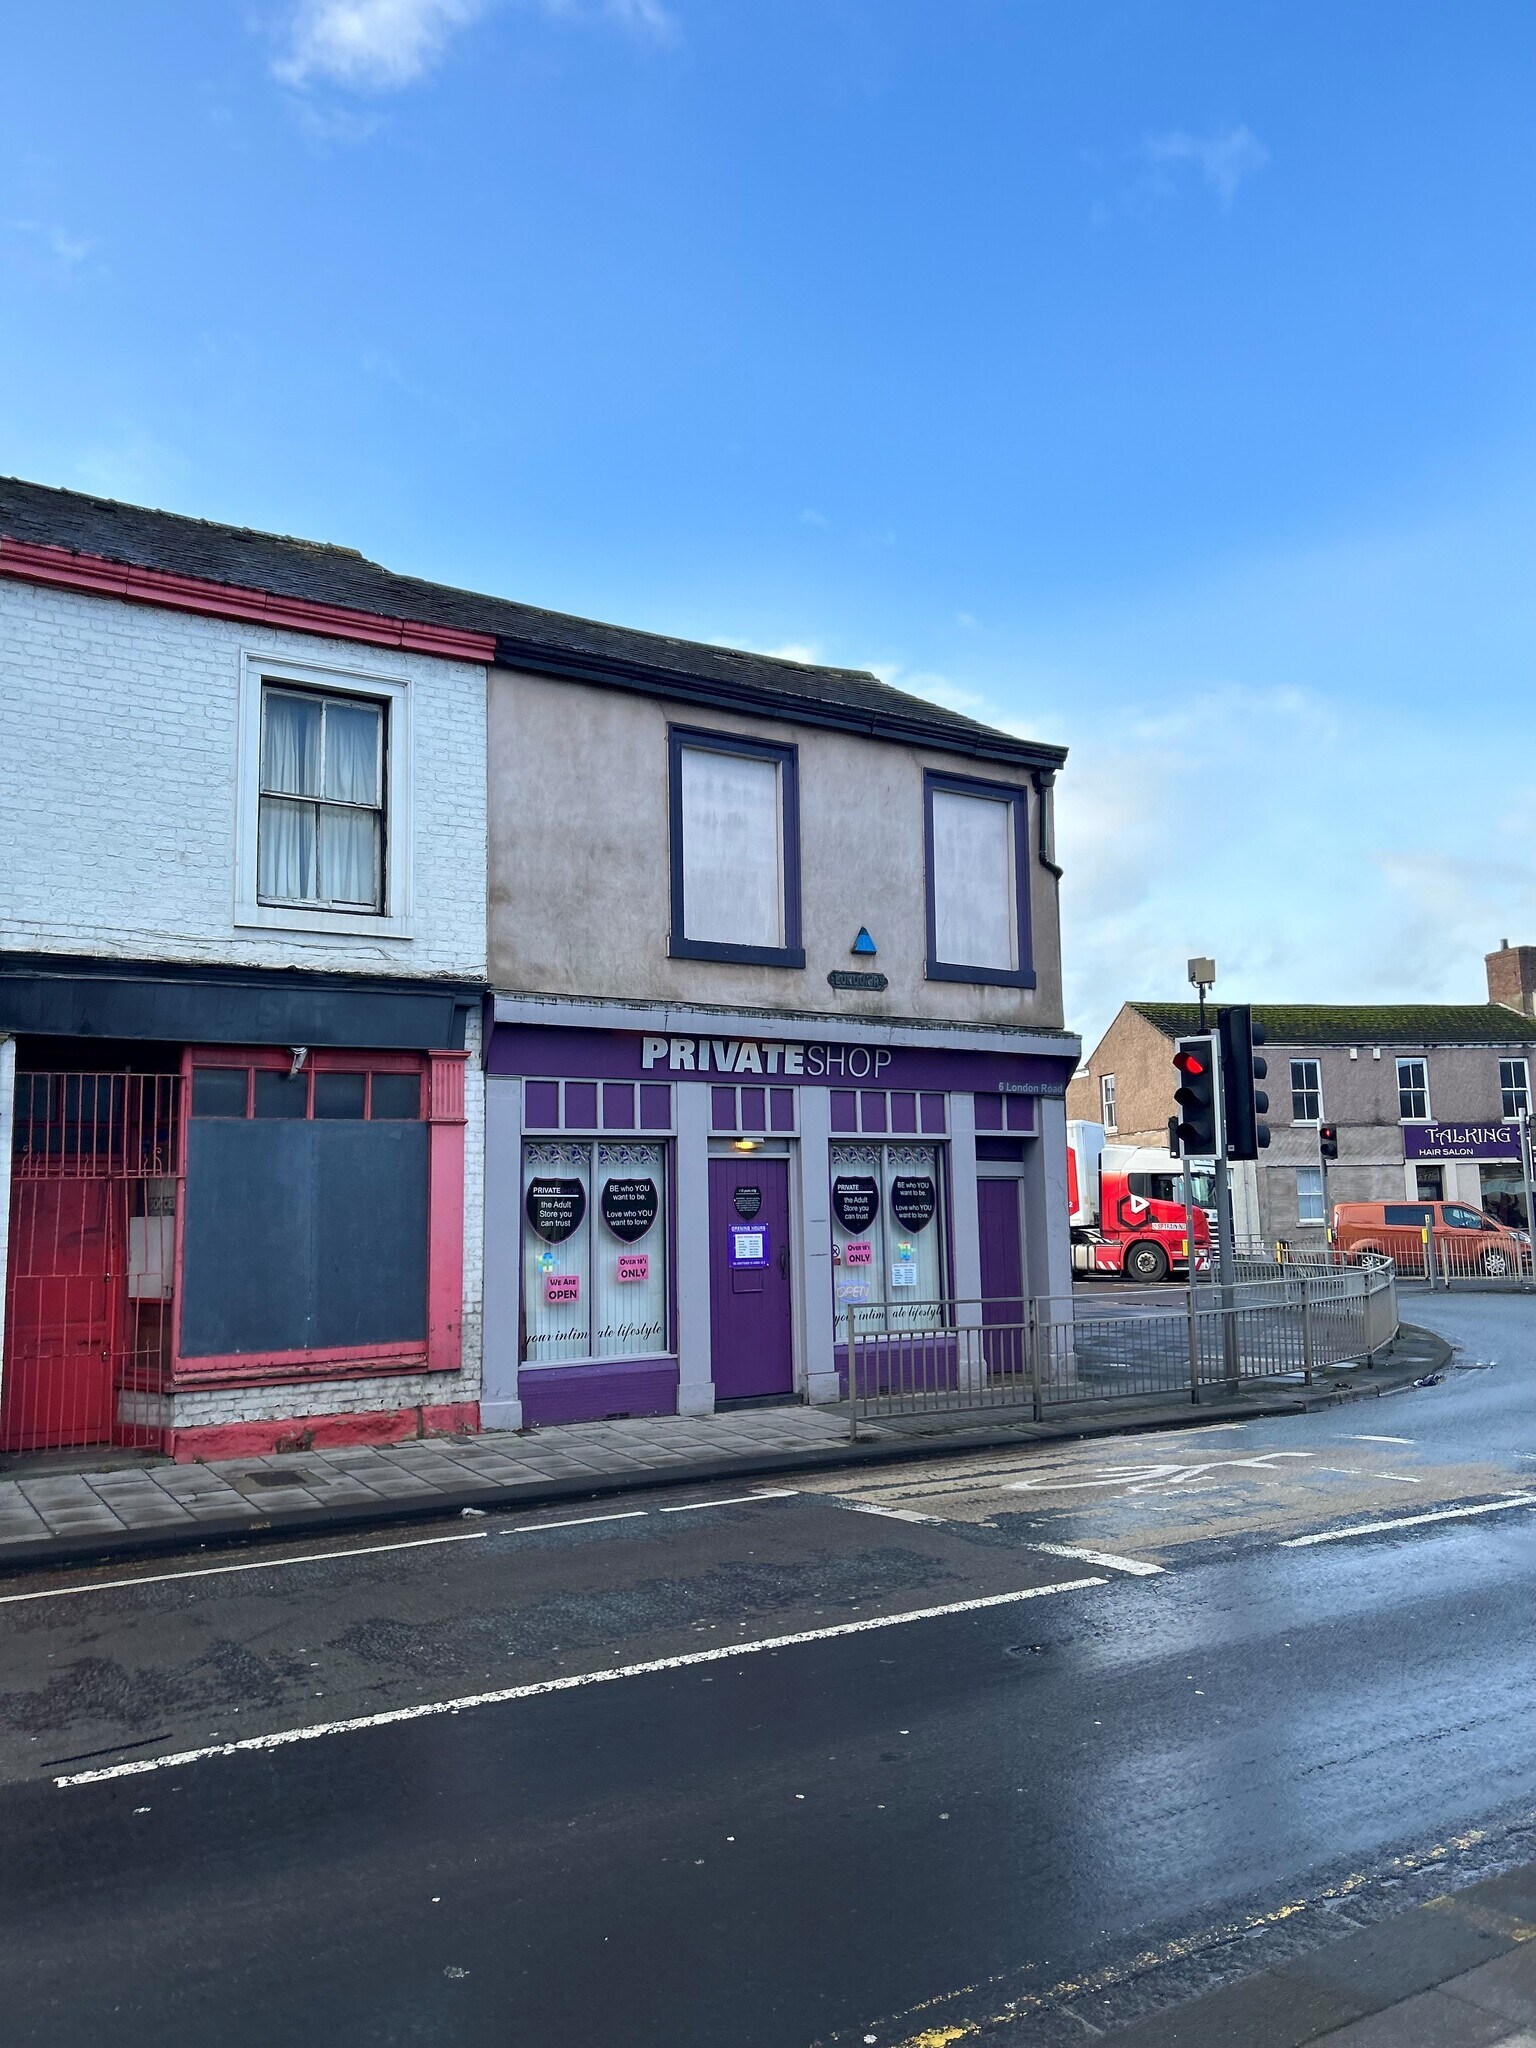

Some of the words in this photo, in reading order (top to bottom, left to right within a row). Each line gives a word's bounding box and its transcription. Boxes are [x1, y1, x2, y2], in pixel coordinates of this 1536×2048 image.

[998, 1082, 1004, 1091] 6
[1006, 1082, 1039, 1093] London
[1041, 1083, 1063, 1093] Road
[1424, 1127, 1511, 1146] TALKING
[1419, 1148, 1442, 1156] HAIR
[1443, 1148, 1474, 1156] SALON
[634, 1184, 650, 1192] YOU
[897, 1181, 906, 1189] BE
[917, 1181, 930, 1189] YOU
[553, 1200, 572, 1209] Adult
[854, 1196, 868, 1204] Adult
[843, 1204, 858, 1212] Store
[539, 1210, 558, 1218] Store
[559, 1211, 573, 1219] you
[606, 1210, 623, 1218] Love
[637, 1209, 653, 1217] YOU
[555, 1219, 571, 1227] trust
[848, 1254, 870, 1263] ONLY
[620, 1268, 647, 1279] ONLY
[548, 1289, 577, 1300] OPEN
[836, 1285, 870, 1298] OPEN
[617, 1321, 662, 1342] lifestyle
